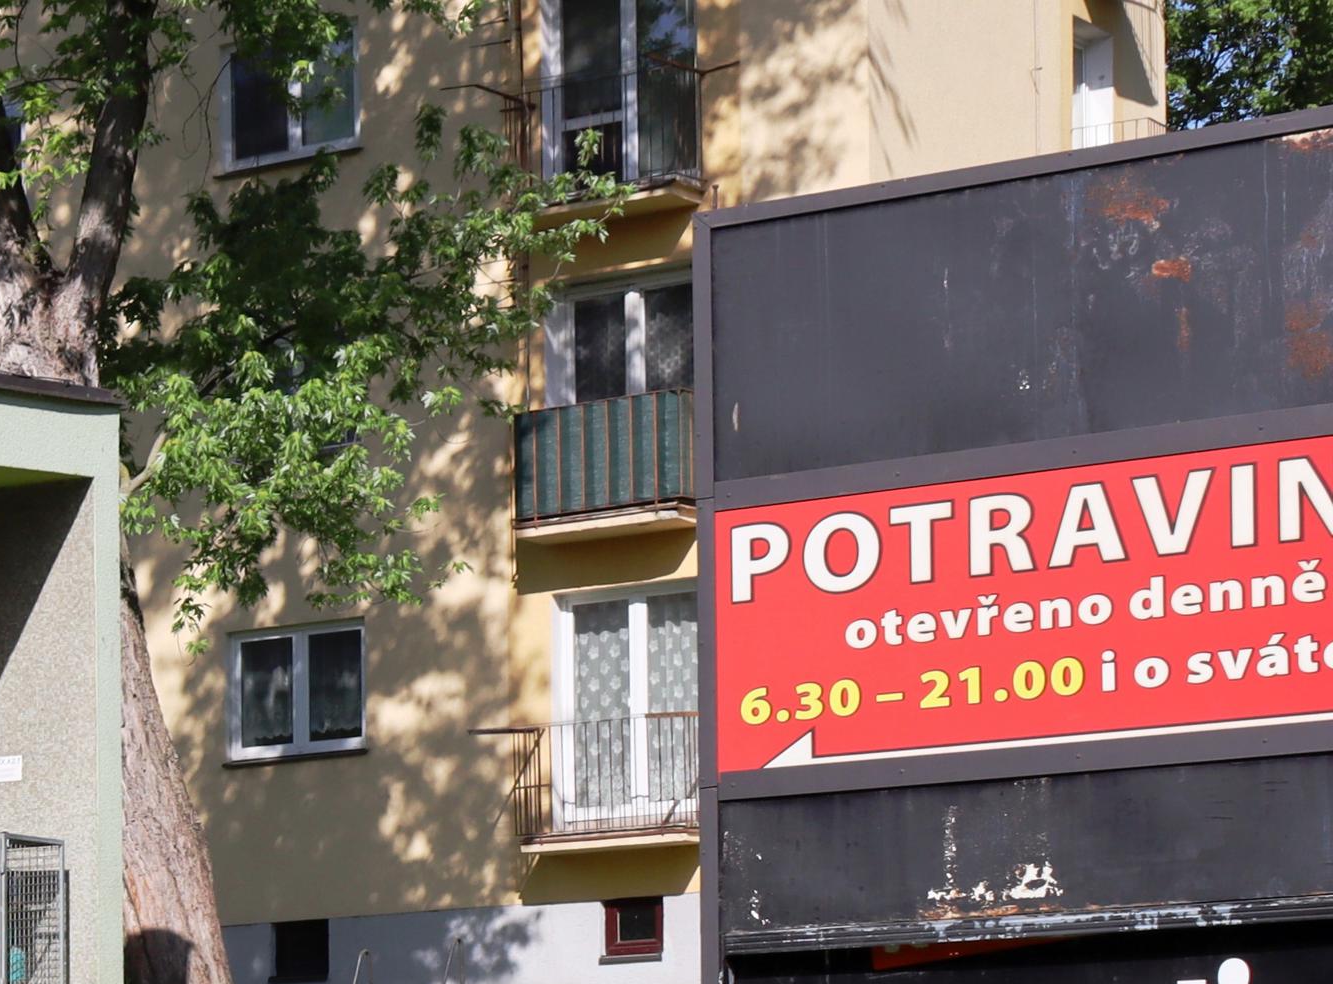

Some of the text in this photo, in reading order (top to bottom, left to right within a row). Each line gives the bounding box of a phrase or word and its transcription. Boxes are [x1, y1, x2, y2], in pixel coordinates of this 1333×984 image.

[844, 560, 1327, 649] otevřeno denně
[740, 677, 861, 725] 6.30
[919, 657, 1085, 709] 21.00
[1100, 650, 1117, 692] i
[1134, 655, 1170, 689] o
